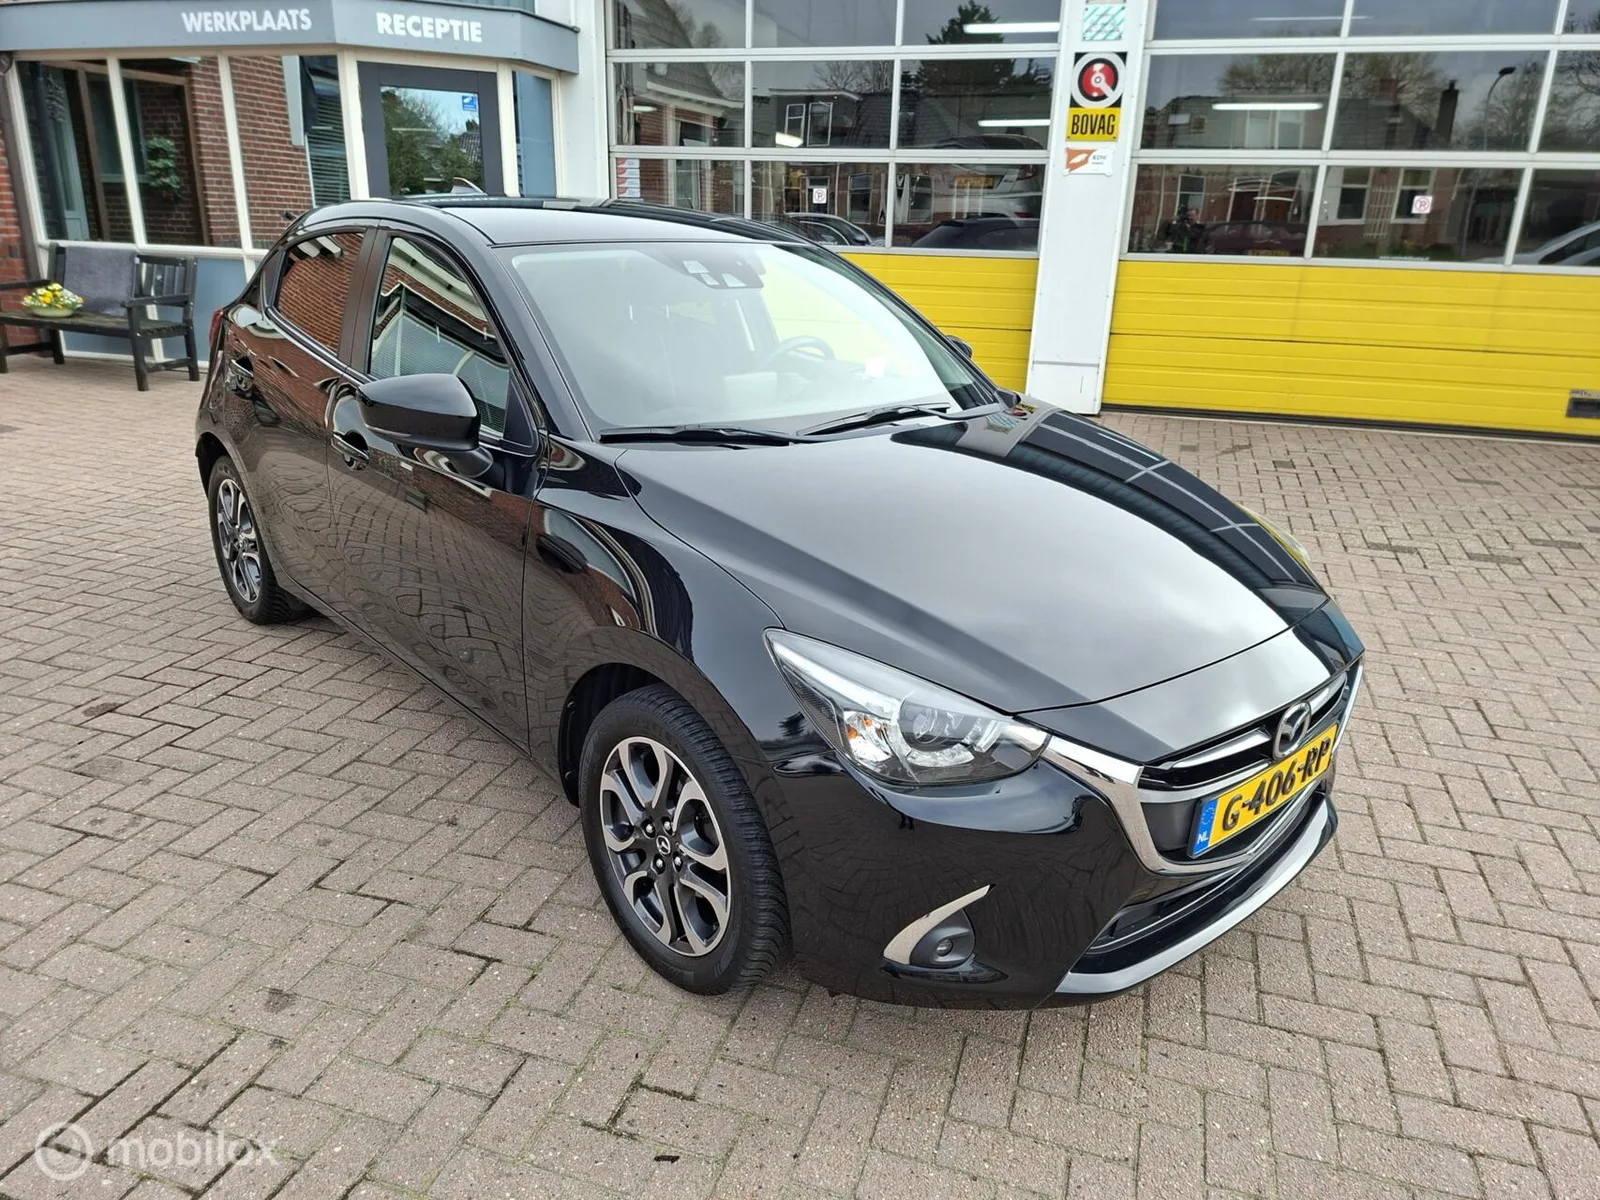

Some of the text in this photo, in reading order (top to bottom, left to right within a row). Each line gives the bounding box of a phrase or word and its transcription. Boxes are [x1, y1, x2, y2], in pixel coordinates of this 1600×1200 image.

[182, 9, 312, 32] WERKPLAATS
[376, 12, 483, 42] RECEPTIE
[1071, 114, 1115, 135] BOVAG
[1222, 737, 1331, 831] G-406-RP
[1196, 830, 1209, 844] NL
